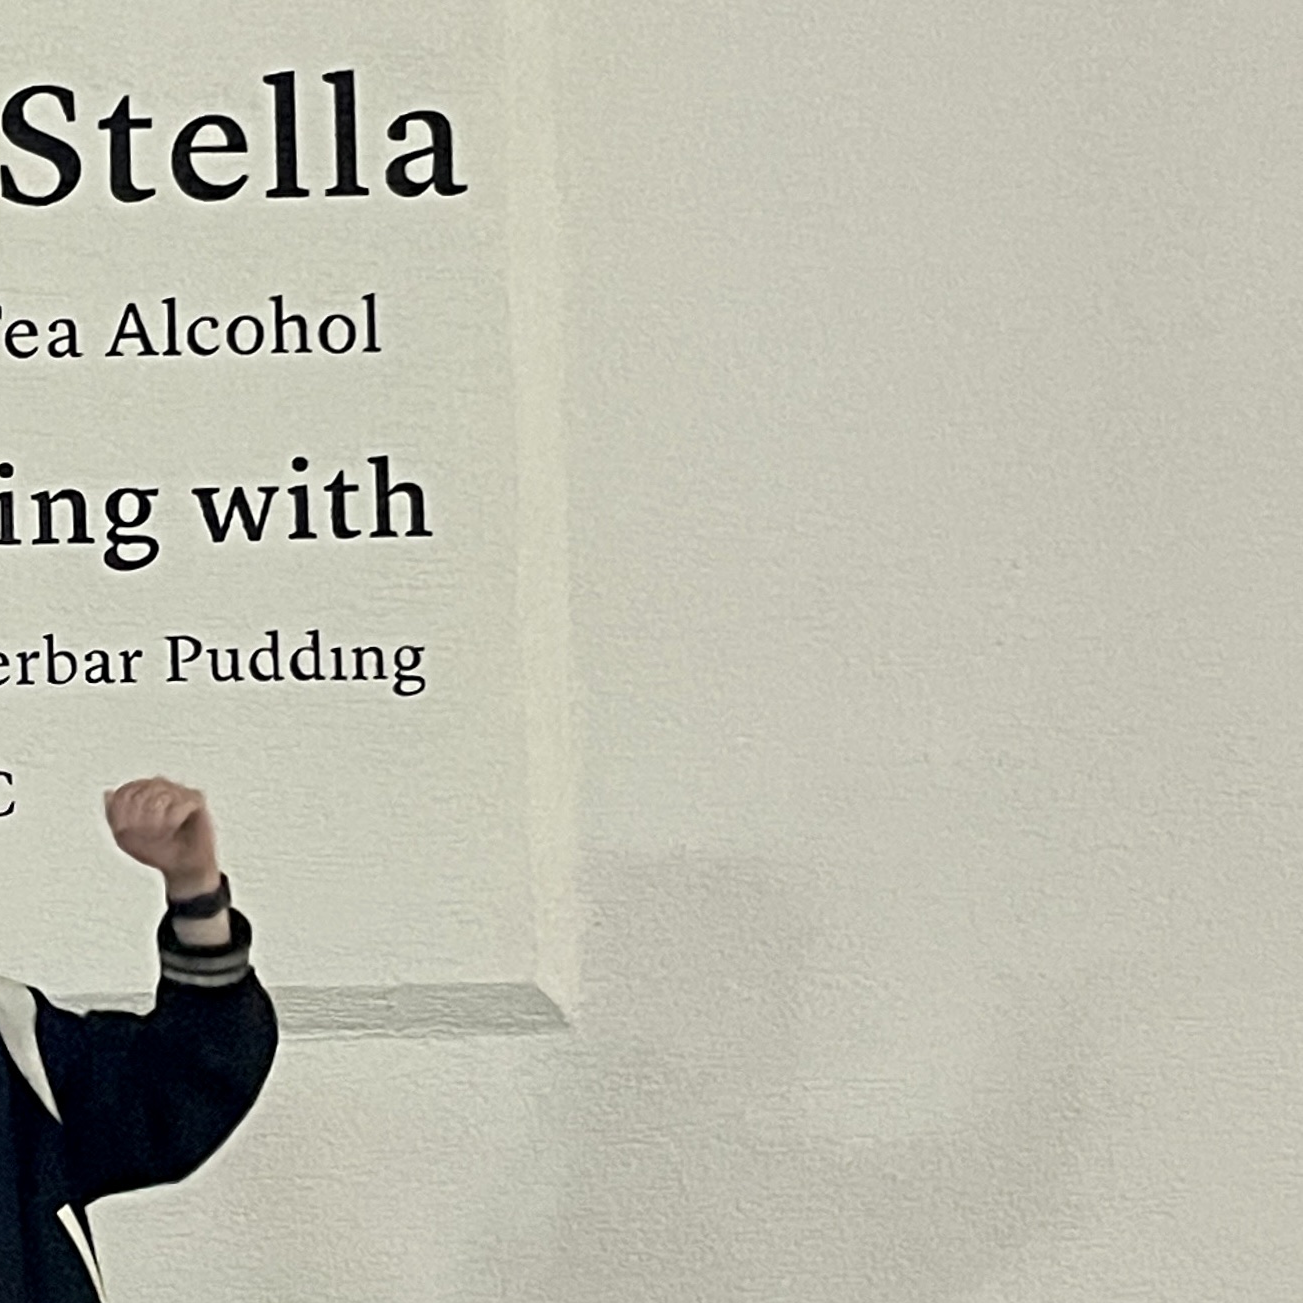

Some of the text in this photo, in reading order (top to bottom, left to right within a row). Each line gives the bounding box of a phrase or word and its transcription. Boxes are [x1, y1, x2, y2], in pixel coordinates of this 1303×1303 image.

[1, 70, 467, 206] Stella
[105, 293, 381, 356] Alcohol
[192, 456, 432, 542] with
